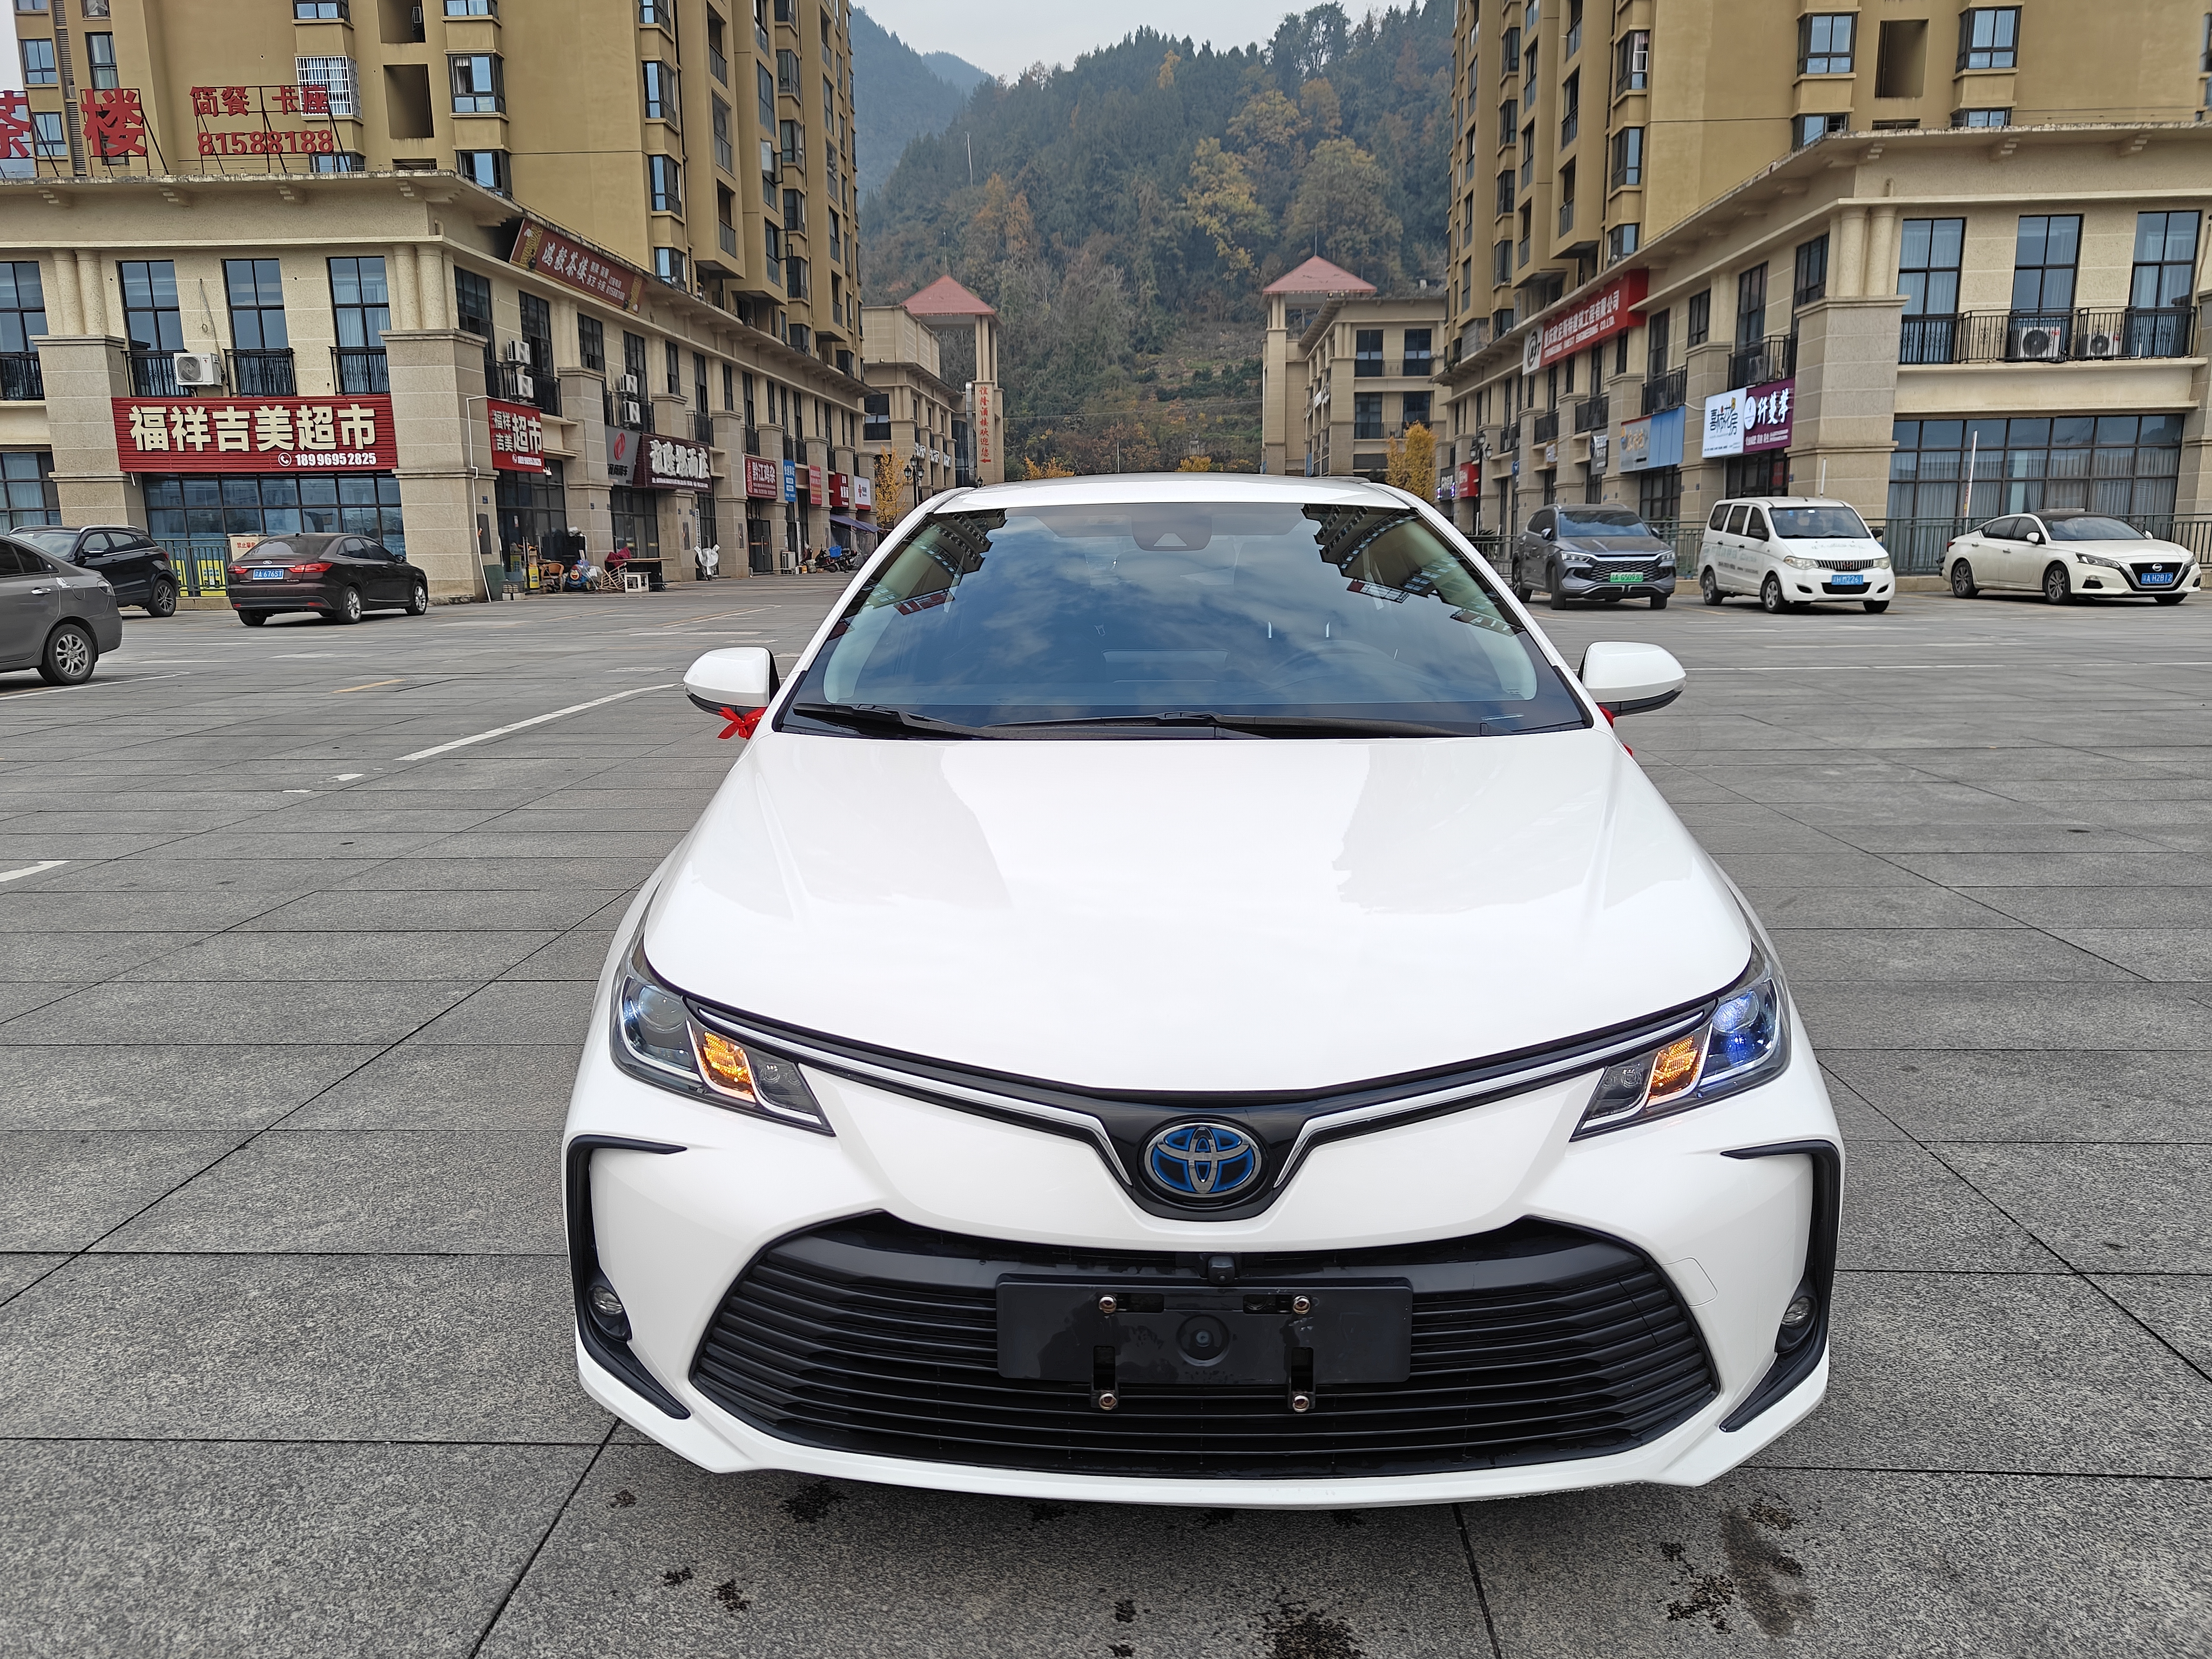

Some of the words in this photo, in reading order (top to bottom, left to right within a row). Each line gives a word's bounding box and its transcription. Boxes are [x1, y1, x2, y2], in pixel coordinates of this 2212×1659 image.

[190, 85, 250, 117] 简餐
[272, 84, 329, 115] 卡座
[197, 130, 334, 156] 81588188
[129, 403, 377, 452] 福祥吉美超市
[493, 409, 512, 430] 福祥
[495, 433, 512, 453] 吉美
[512, 413, 542, 454] 超市
[295, 452, 377, 466] 18996952825
